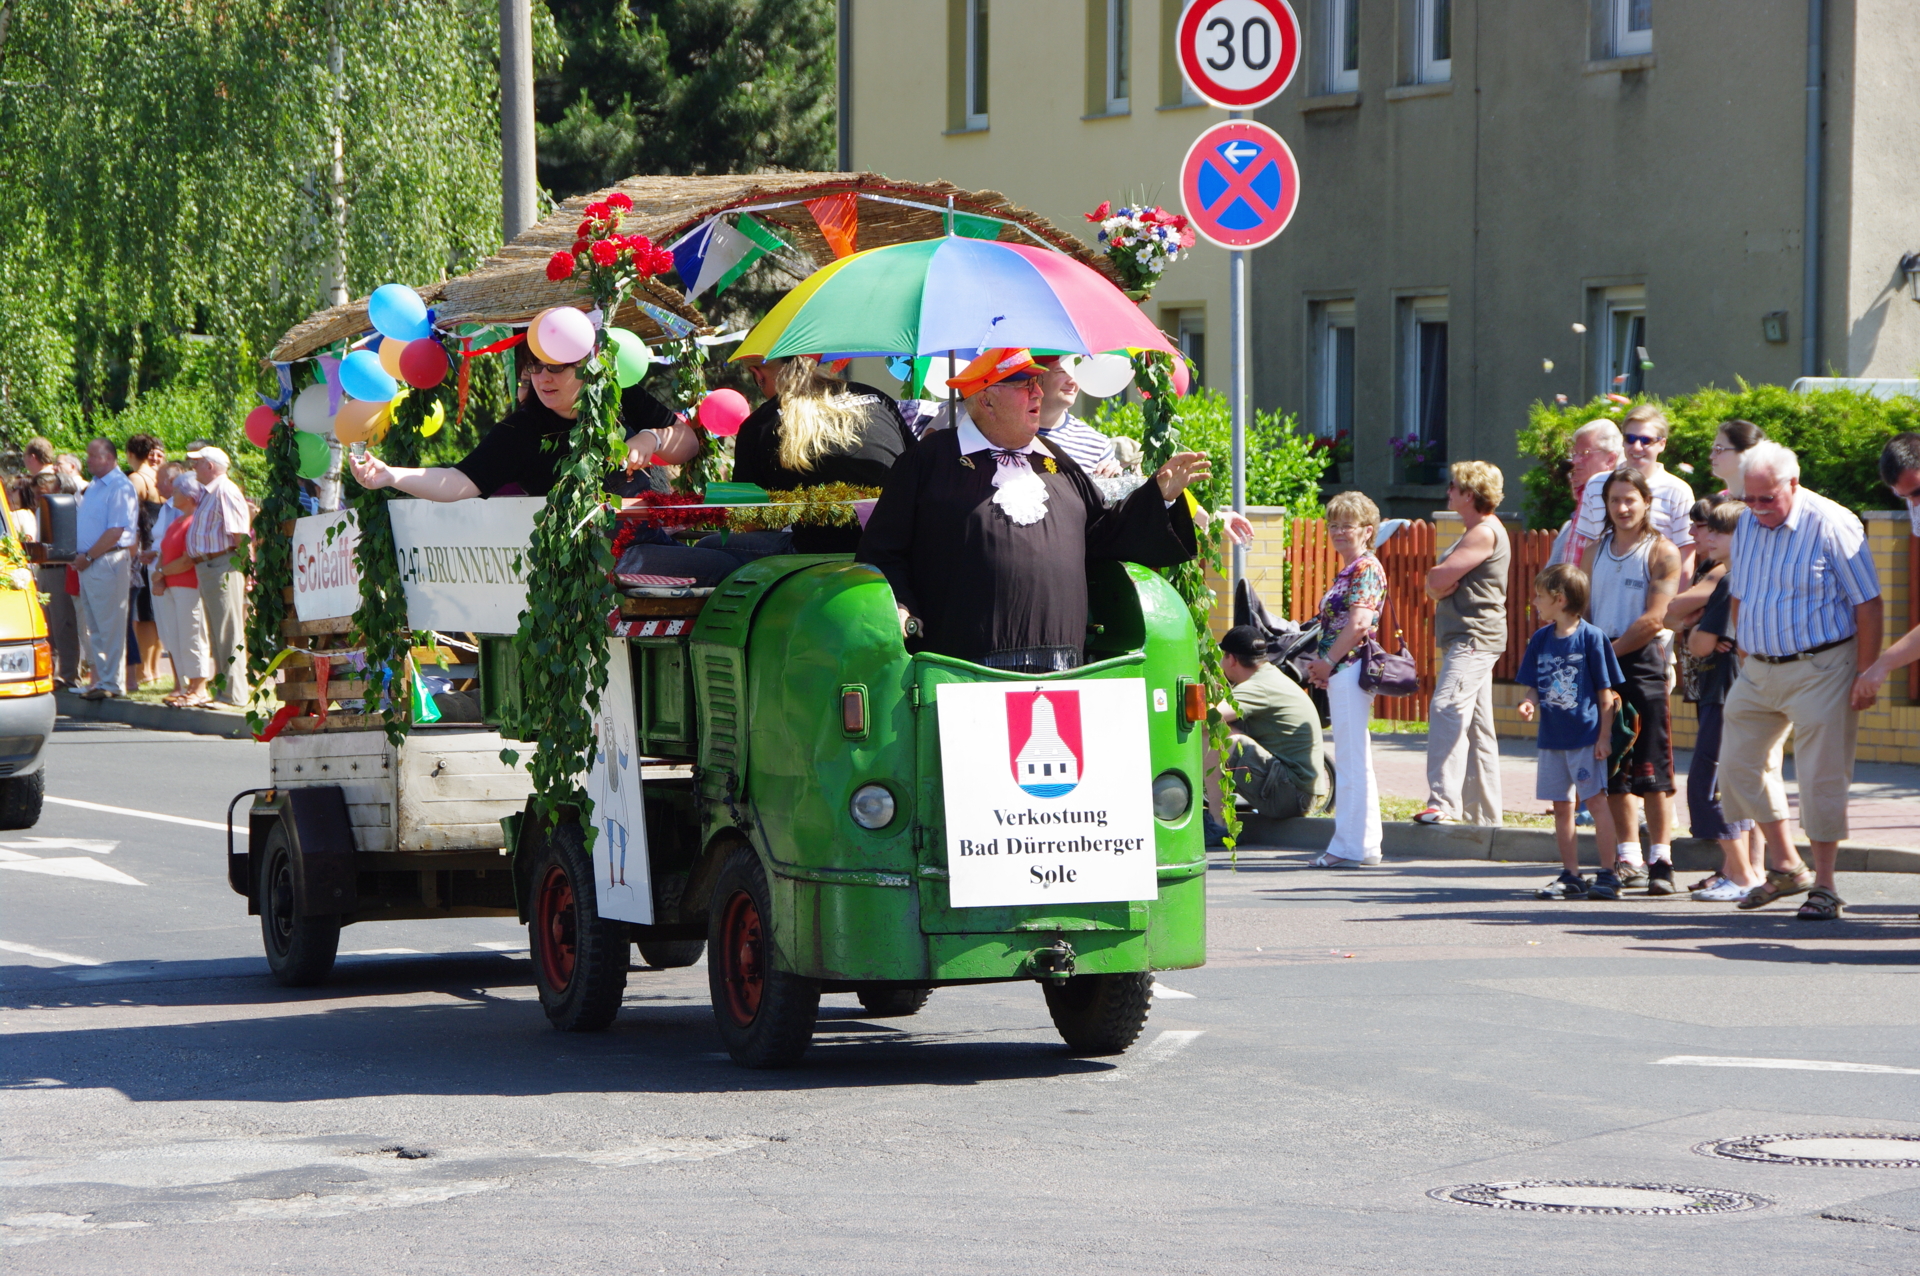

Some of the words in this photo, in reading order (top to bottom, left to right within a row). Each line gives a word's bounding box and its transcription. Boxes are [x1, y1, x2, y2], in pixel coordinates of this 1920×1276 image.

[1206, 16, 1271, 71] 30
[993, 808, 1108, 827] Verkostung
[959, 838, 999, 857] Bad
[1006, 835, 1144, 856] Dürrenberger
[1030, 865, 1077, 884] Sole
